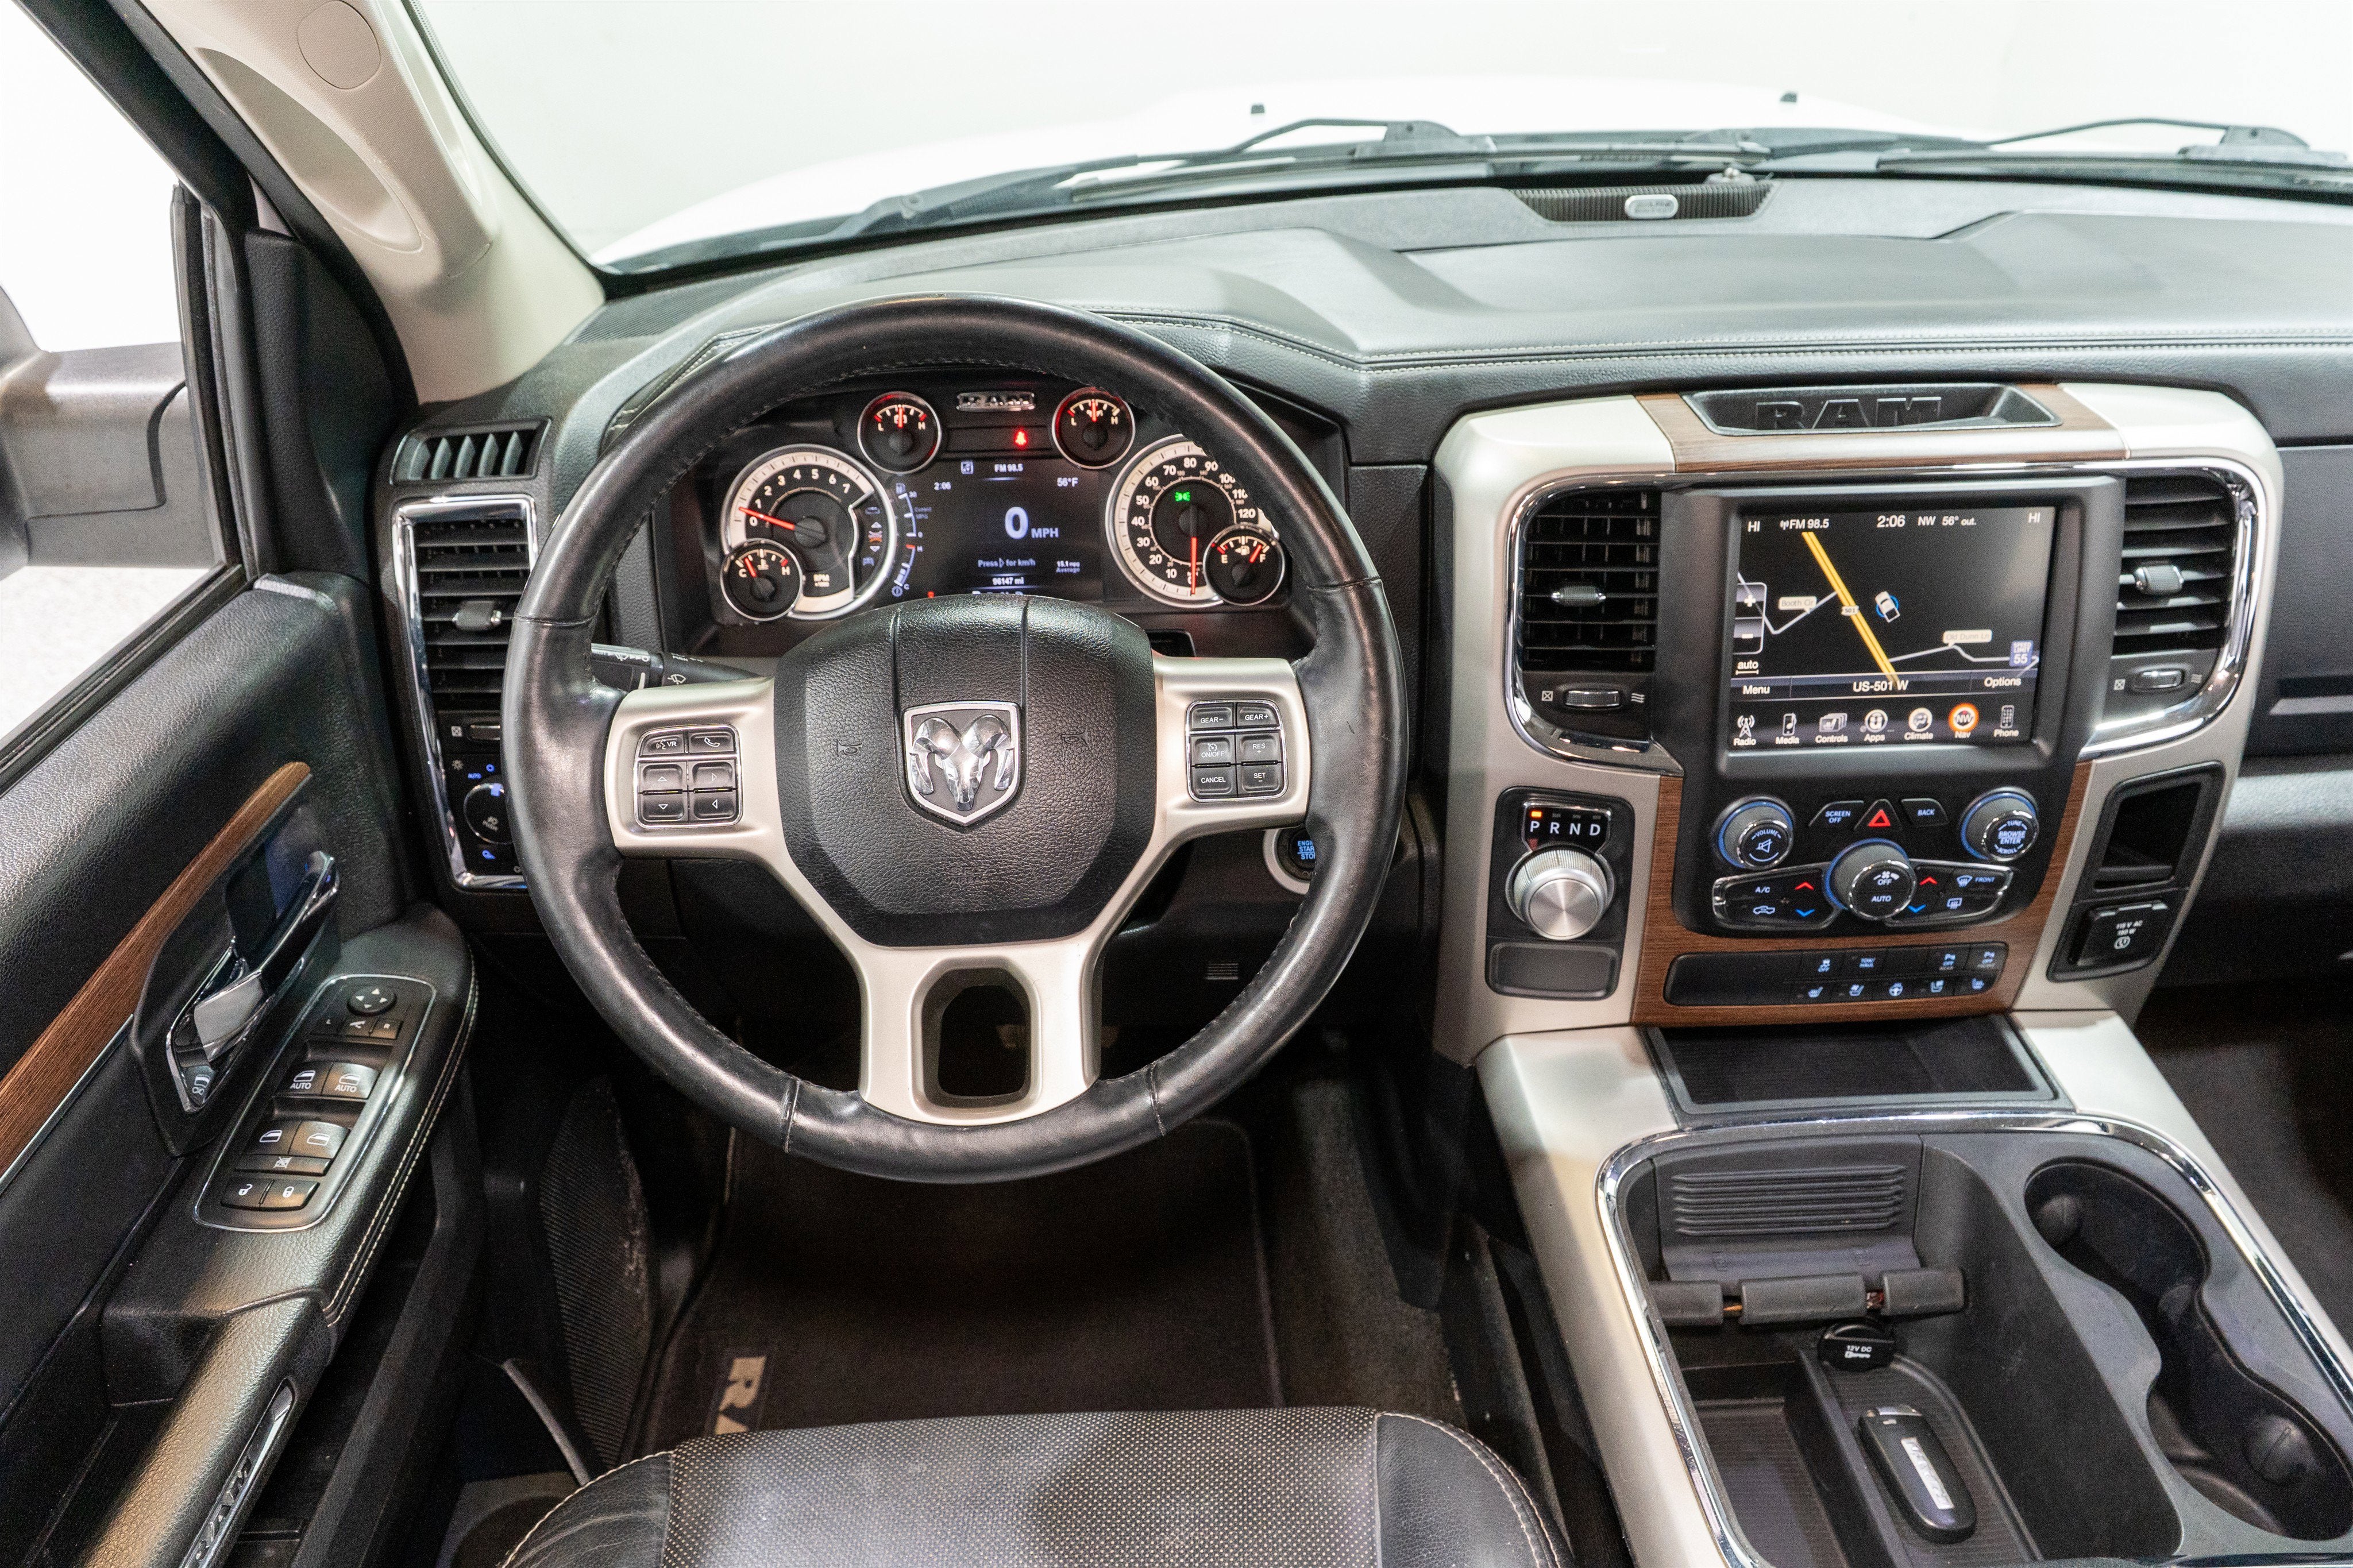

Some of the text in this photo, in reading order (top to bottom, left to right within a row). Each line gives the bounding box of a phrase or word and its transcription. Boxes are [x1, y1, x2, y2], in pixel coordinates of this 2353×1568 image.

[1071, 417, 1077, 426] L
[1111, 416, 1118, 424] H
[878, 423, 884, 431] L
[918, 422, 925, 430] H
[1183, 457, 1197, 468] 80
[1205, 461, 1218, 472] 90
[994, 464, 1006, 472] FM
[1163, 465, 1176, 476] 70
[793, 469, 801, 480] 4
[811, 469, 819, 479] 5
[1219, 473, 1235, 484] 100
[778, 475, 785, 485] 3
[828, 474, 836, 485] 6
[1145, 476, 1159, 487] 60
[764, 485, 772, 496] 2
[843, 484, 850, 493] 7
[934, 482, 951, 490] 2:06
[755, 499, 762, 509] 1
[1136, 495, 1149, 505] 50
[1238, 508, 1256, 519] 120
[2028, 512, 2041, 523] HI
[749, 516, 758, 527] 0
[1005, 506, 1029, 539] 0
[1131, 516, 1145, 527] 40
[1789, 519, 1830, 529] FM 98.5
[1877, 515, 1906, 528] 2:06
[1918, 516, 1937, 526] NW
[1942, 515, 1959, 526] 56°
[1748, 521, 1761, 532] HI
[1031, 527, 1059, 539] MPH
[1137, 536, 1150, 547] 30
[978, 559, 998, 567] Press
[1006, 559, 1017, 567] for
[1149, 554, 1163, 565] 20
[1221, 554, 1228, 563] E
[1259, 553, 1266, 563] F
[739, 568, 747, 578] C
[781, 566, 790, 576] H
[1166, 568, 1177, 578] 10
[2013, 654, 2028, 664] 55
[1737, 660, 1759, 670] auto
[1853, 680, 1909, 692] US-501 W
[1984, 677, 2022, 689] Options
[1742, 685, 1770, 694] Menu
[1956, 715, 1972, 723] NW
[1864, 733, 1885, 742] Apps
[1904, 732, 1934, 740] Climate
[1993, 729, 2019, 737] Phone
[1733, 737, 1757, 746] Radio
[1775, 736, 1800, 744] Media
[1815, 734, 1848, 743] Controls
[1201, 750, 1224, 758] ON/OFF
[1530, 820, 1601, 836] P R N D
[1755, 828, 1779, 837] VOLUME
